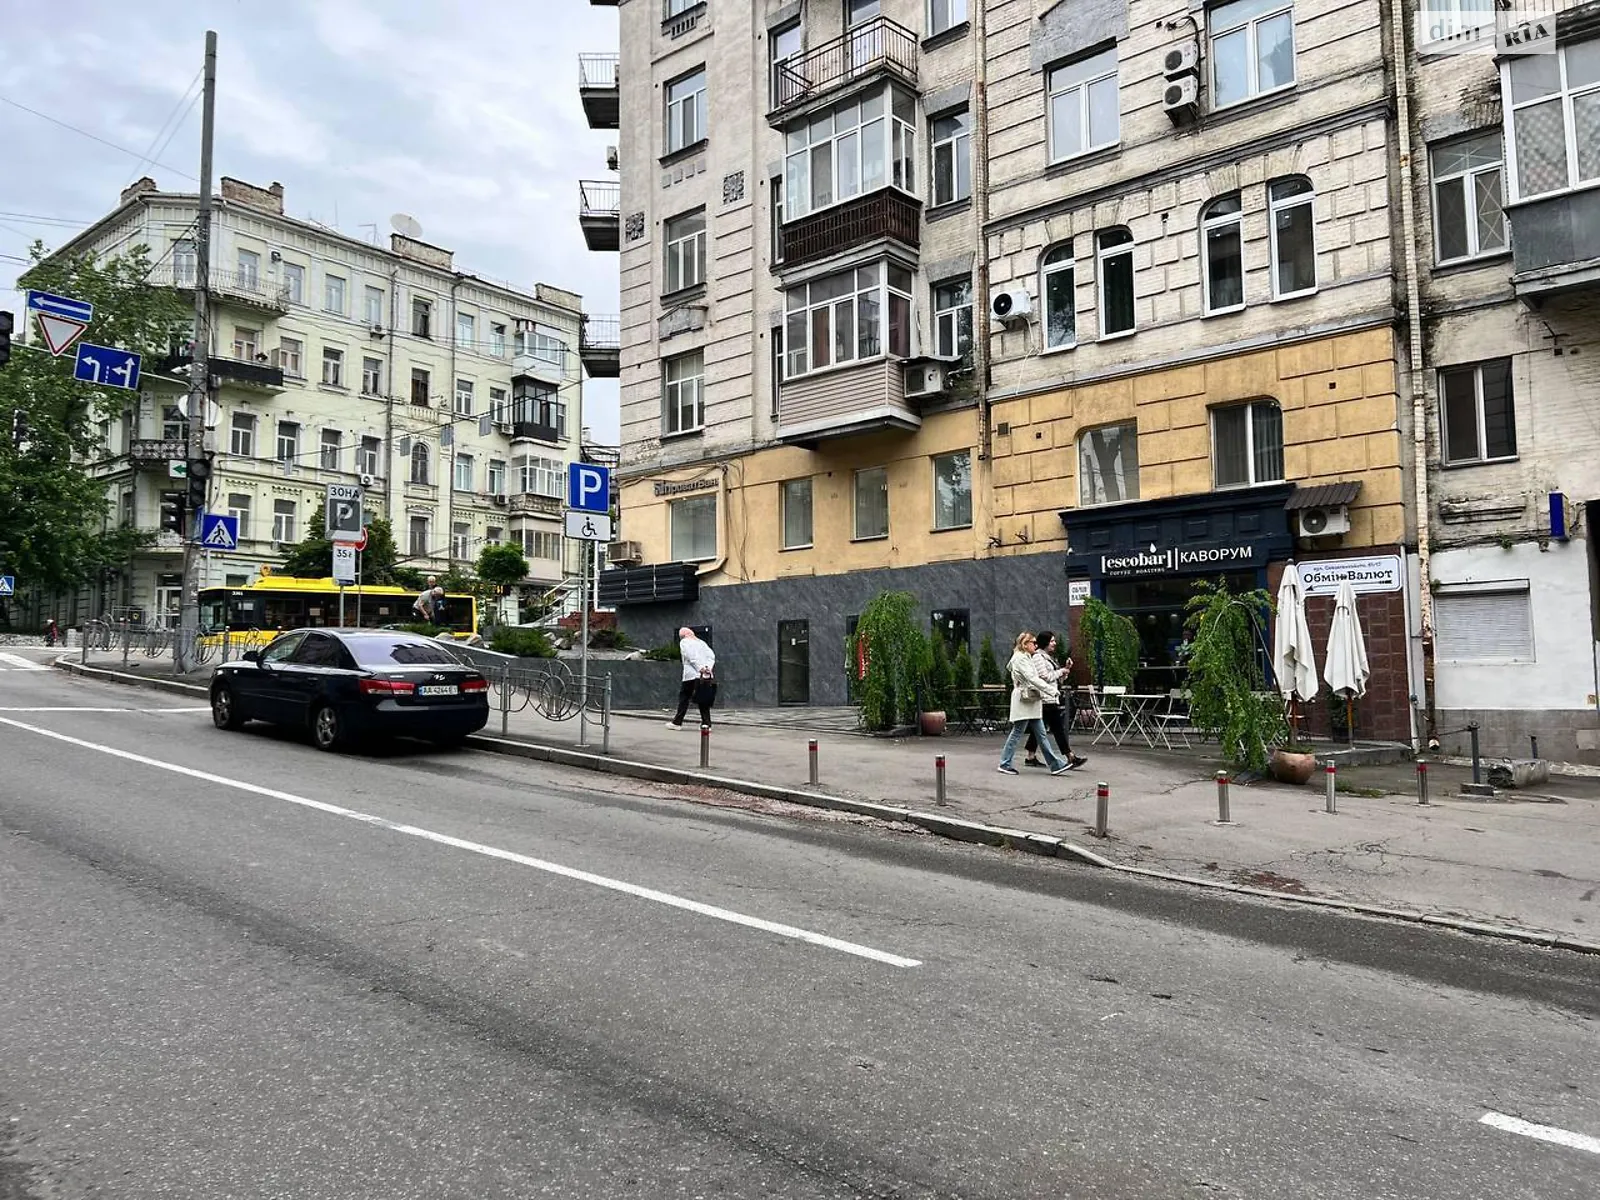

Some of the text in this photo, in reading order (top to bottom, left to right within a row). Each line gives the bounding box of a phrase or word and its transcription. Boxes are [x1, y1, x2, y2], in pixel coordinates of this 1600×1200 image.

[330, 486, 360, 498] ЗОНА
[579, 468, 602, 506] P
[1180, 546, 1252, 563] КАВОРУМ
[1347, 569, 1393, 581] Валют
